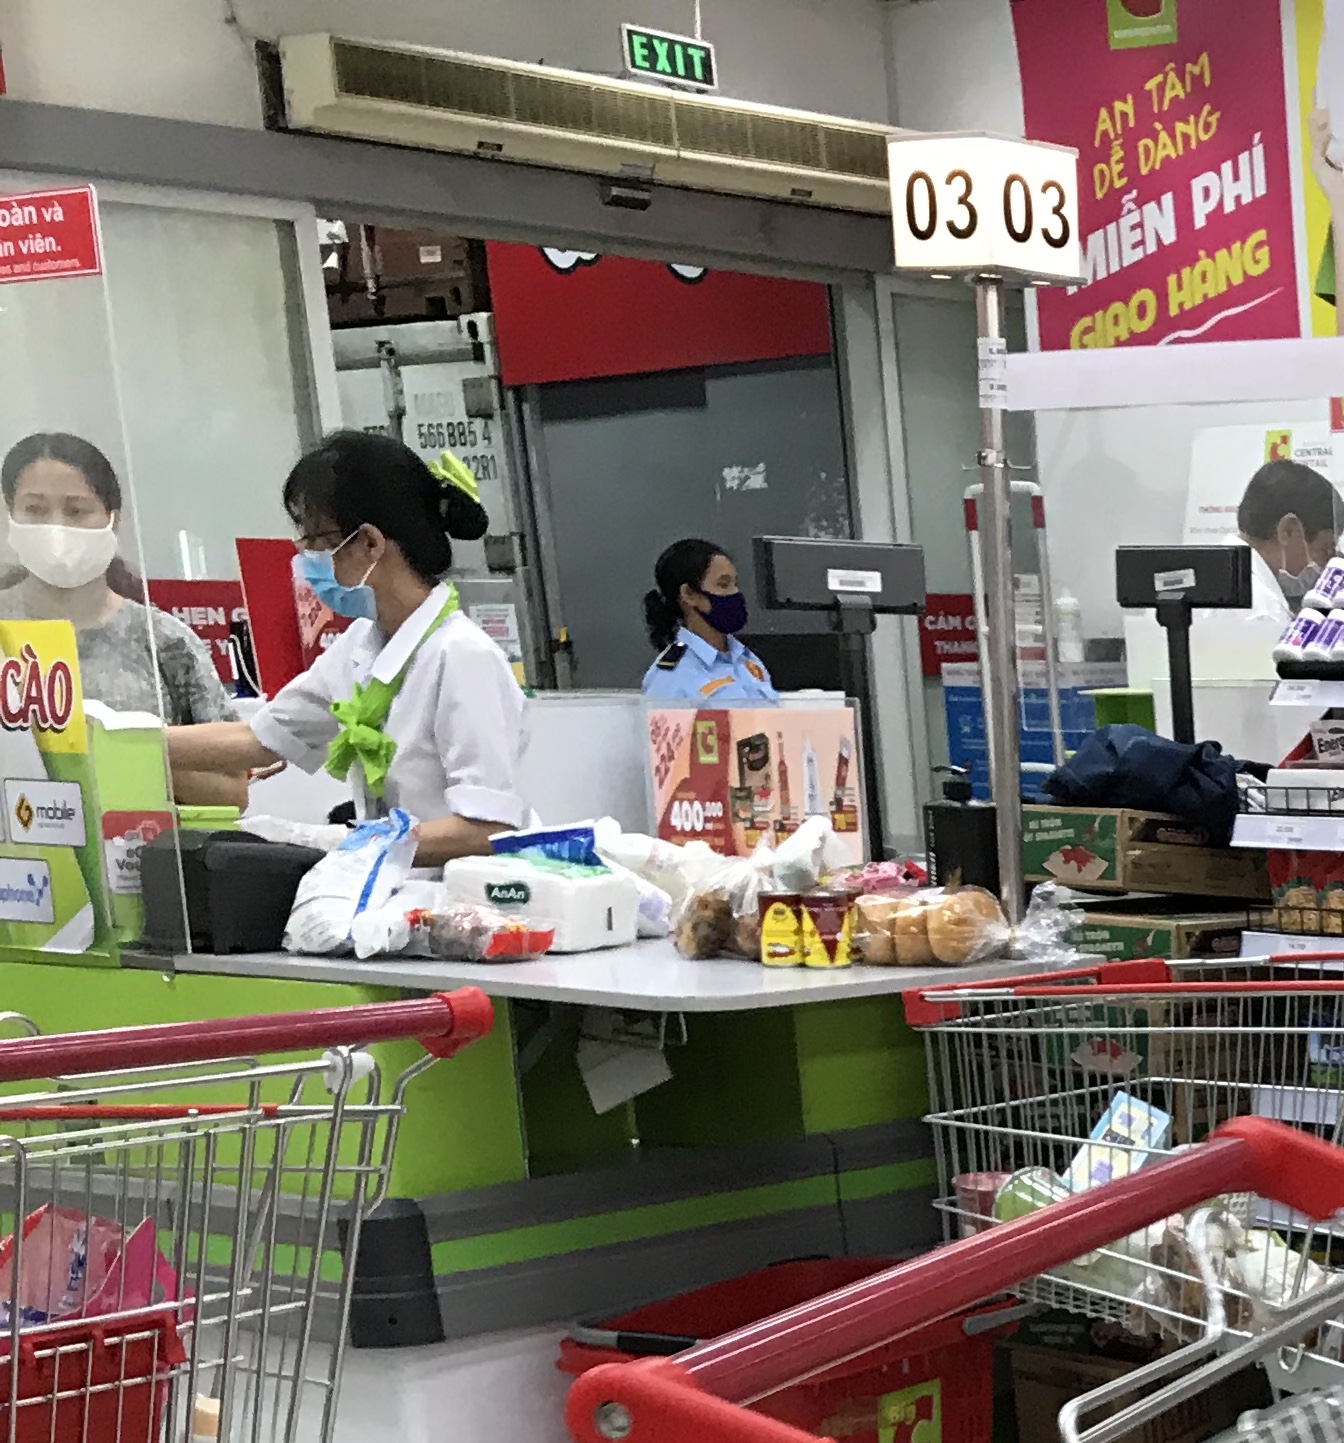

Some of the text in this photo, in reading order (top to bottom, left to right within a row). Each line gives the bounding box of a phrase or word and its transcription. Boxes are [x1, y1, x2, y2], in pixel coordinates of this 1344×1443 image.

[631, 36, 706, 81] EXIT
[1094, 52, 1211, 147] AN TÂM
[1093, 103, 1222, 200] DỄ DÀNG
[1190, 130, 1266, 230] PHÍ
[18, 232, 62, 254] viên.
[41, 200, 64, 222] và
[906, 168, 977, 241] 03
[1003, 172, 1070, 249] 03
[1070, 228, 1269, 350] GIAO HÀNG
[0, 644, 73, 729] CÀO
